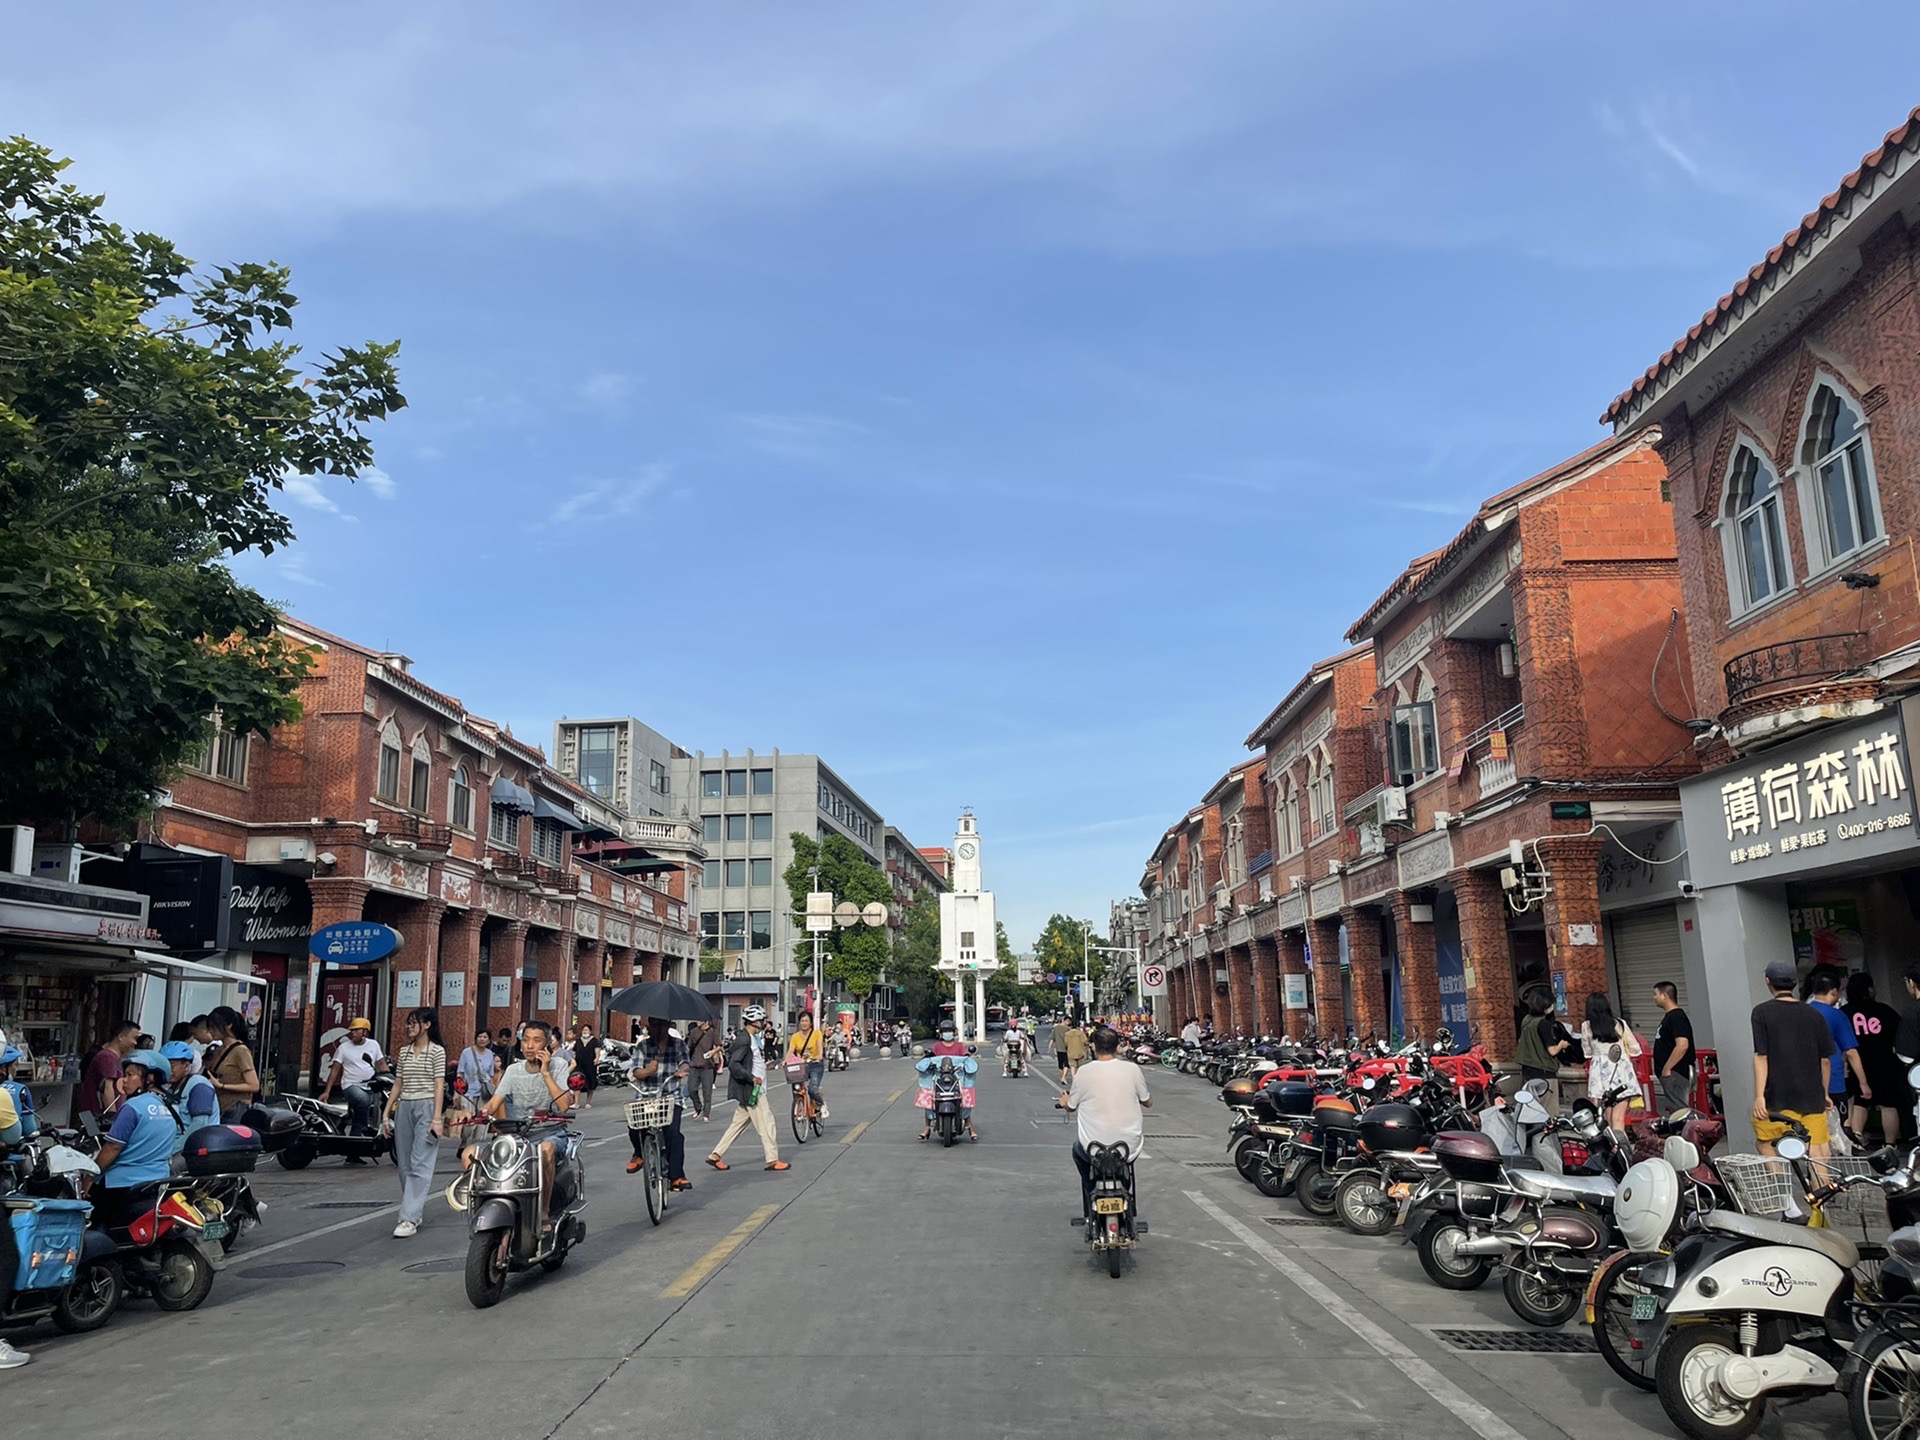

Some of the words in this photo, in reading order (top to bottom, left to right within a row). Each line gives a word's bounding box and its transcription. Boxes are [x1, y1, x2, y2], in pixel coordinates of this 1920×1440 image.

[1720, 731, 1907, 841] 薄荷森林
[1848, 812, 1911, 837] 400-016-8686
[230, 885, 263, 914] Daily
[245, 917, 299, 942] Welcome
